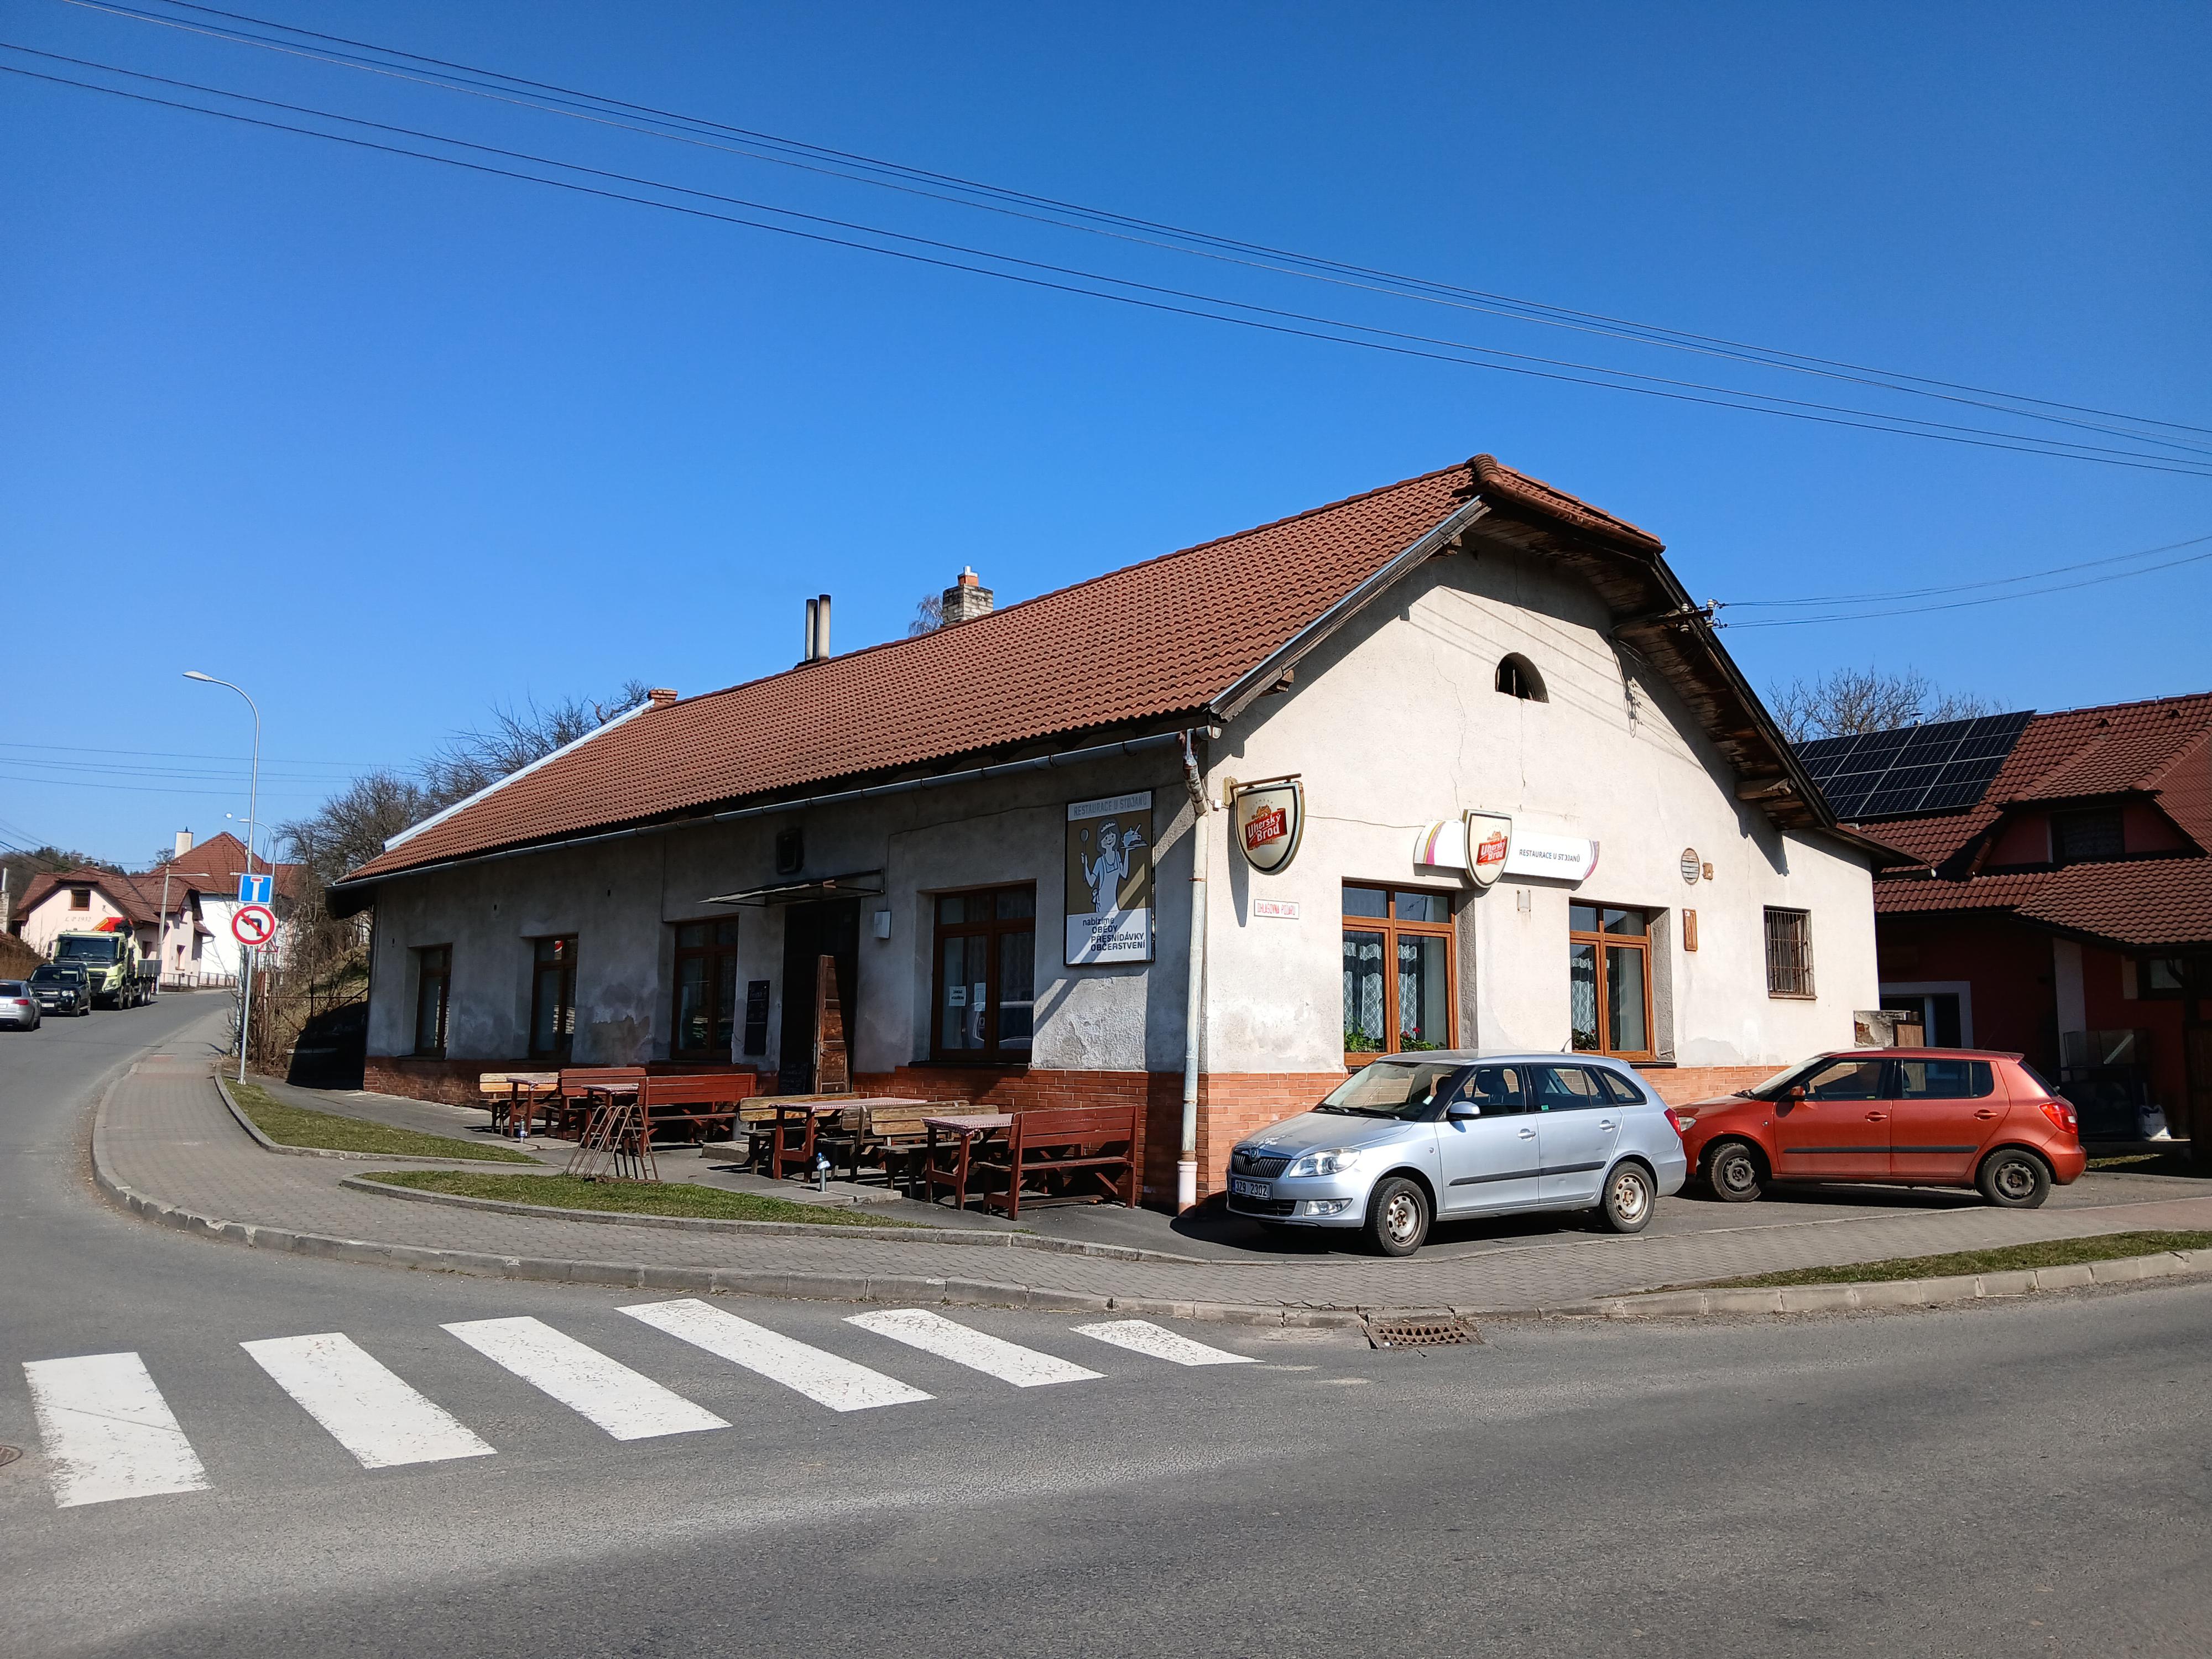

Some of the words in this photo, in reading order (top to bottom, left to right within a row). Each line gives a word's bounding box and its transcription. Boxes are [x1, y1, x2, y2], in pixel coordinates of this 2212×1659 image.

[1074, 801, 1112, 816] RESTAURACE
[1114, 799, 1118, 809] U
[1248, 813, 1281, 838] Uherský
[1256, 822, 1280, 842] Brod
[1488, 849, 1504, 861] Brod
[1519, 849, 1552, 859] RESTAURACE
[1082, 916, 1115, 926] nabízíme
[1092, 924, 1118, 934] OBĚDY
[1091, 931, 1145, 943] PŘESNÍDÁVKY
[1091, 940, 1146, 952] OBČERSTVENÍ
[1236, 1181, 1246, 1192] 3Z9
[1250, 1183, 1267, 1196] 2302
